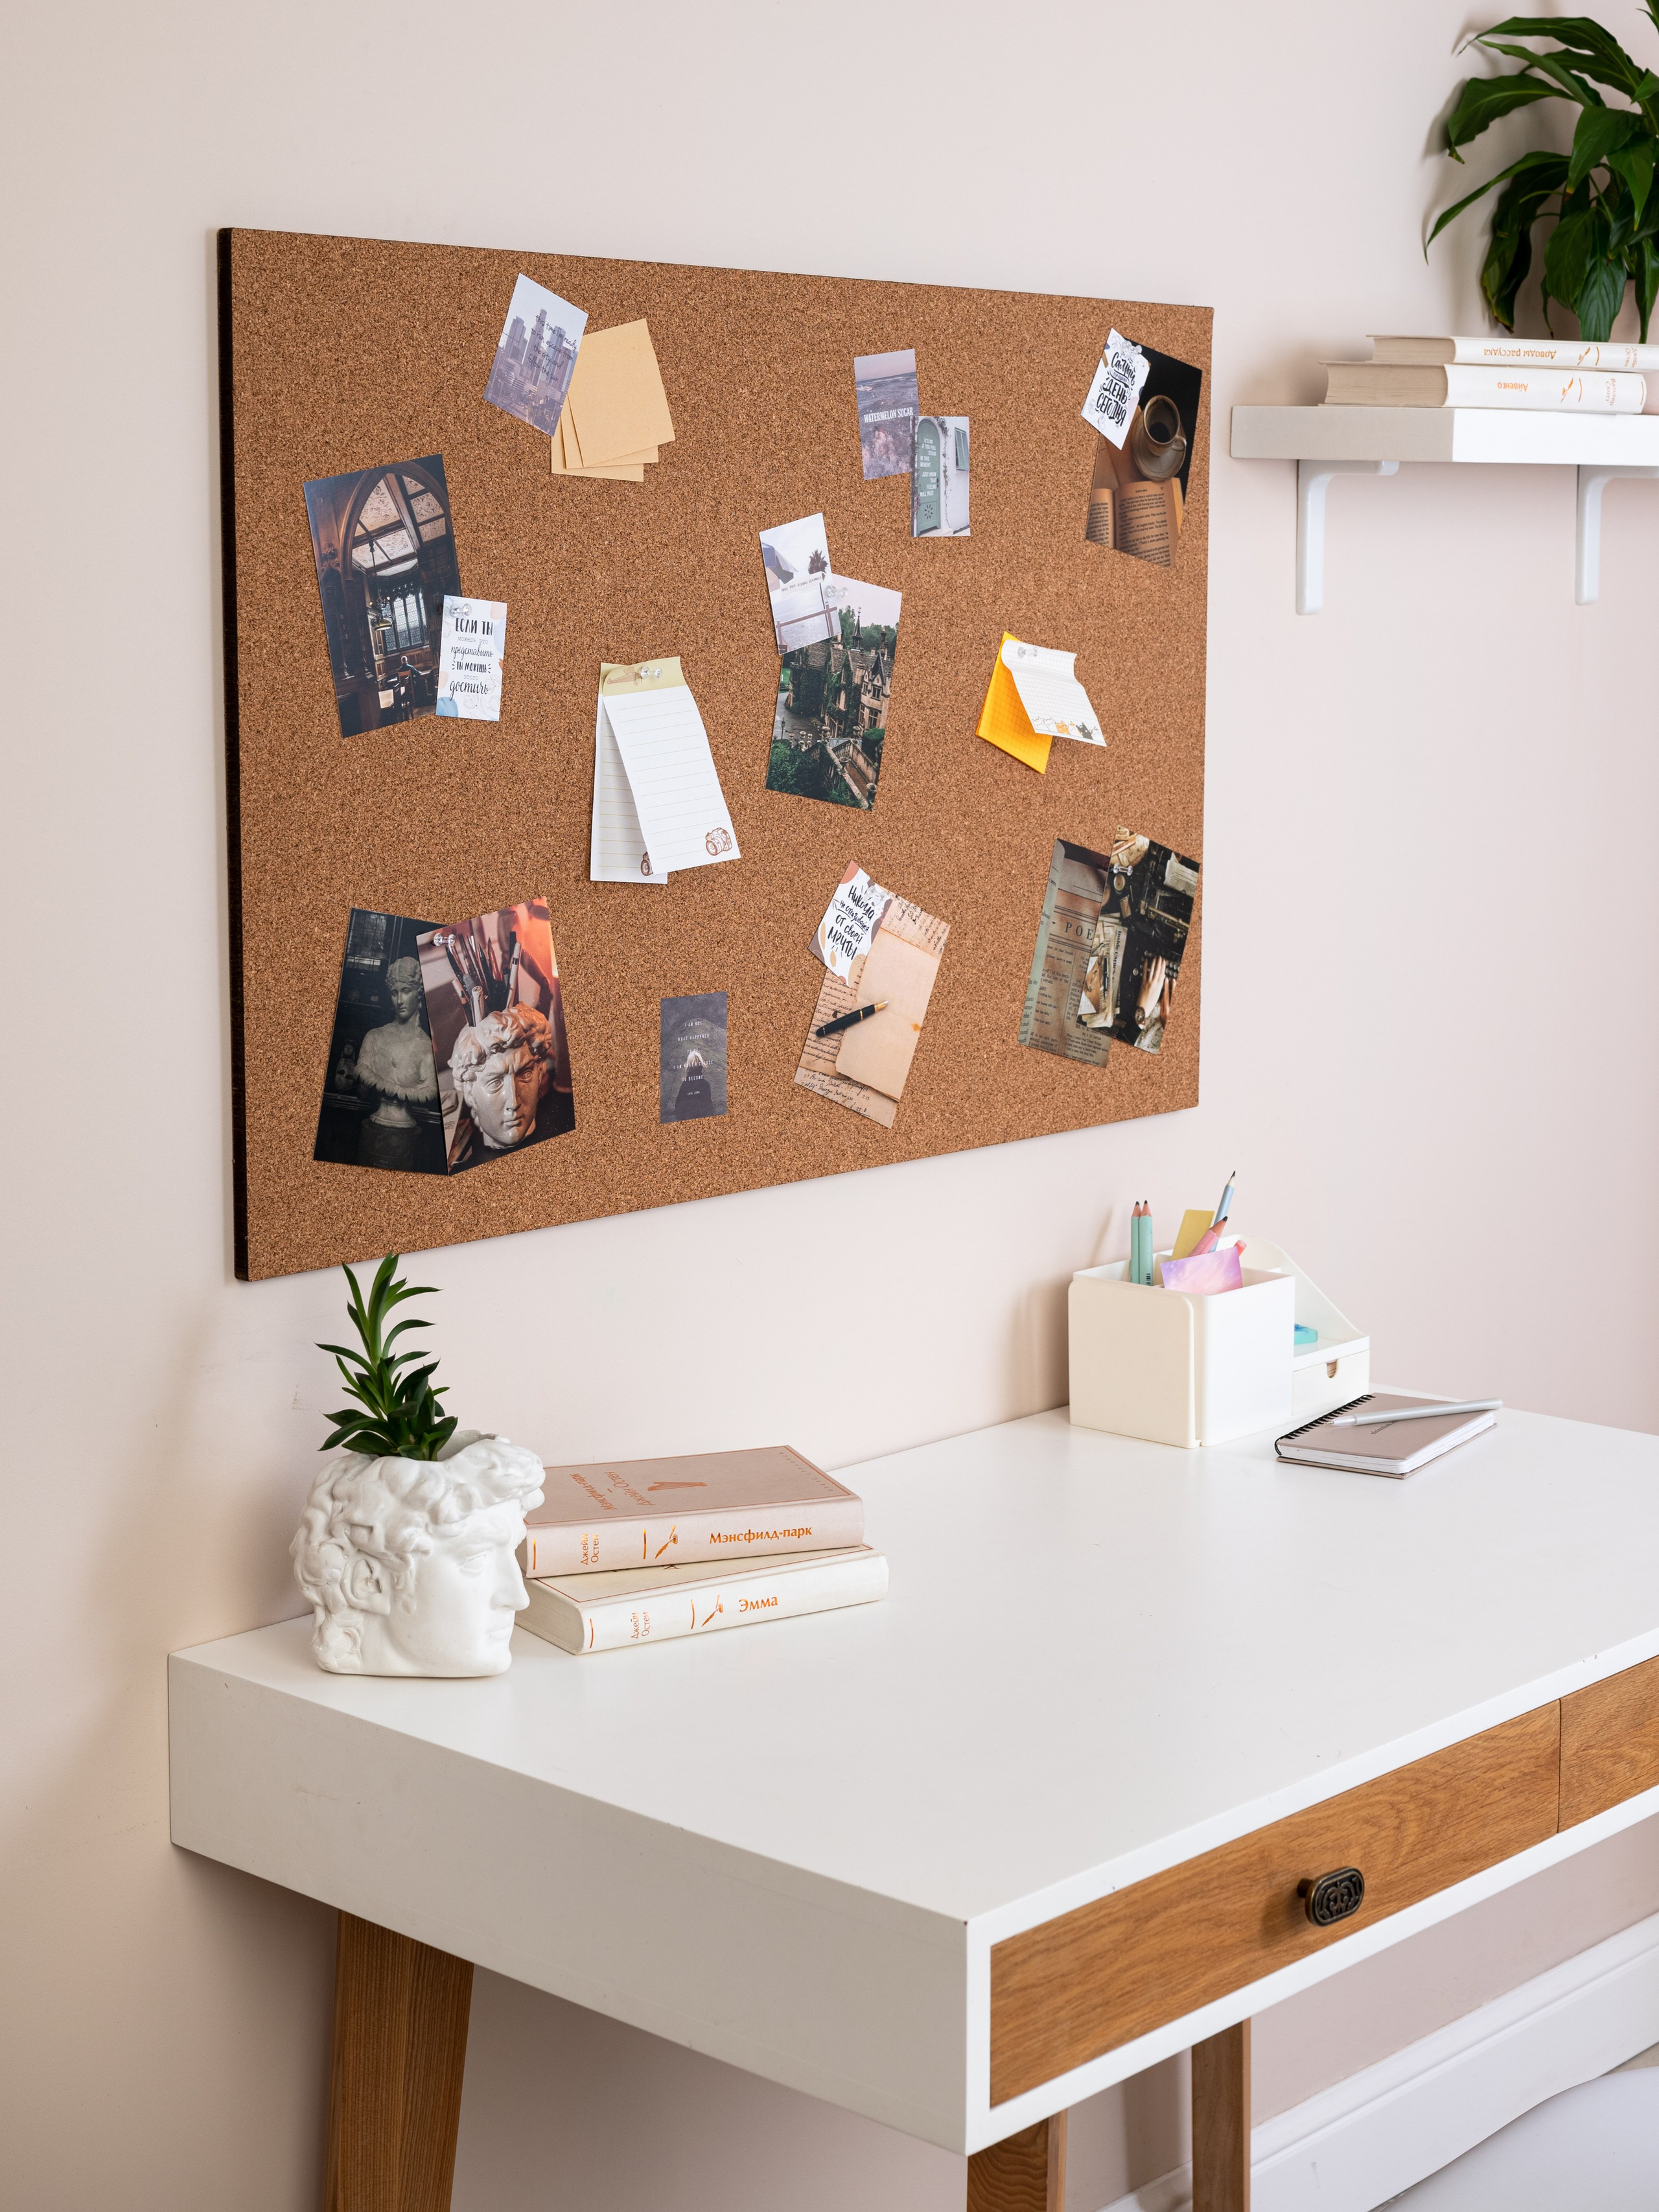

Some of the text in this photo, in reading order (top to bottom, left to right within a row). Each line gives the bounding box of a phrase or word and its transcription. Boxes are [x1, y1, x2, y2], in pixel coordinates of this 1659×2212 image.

[535, 313, 545, 327] this
[546, 323, 556, 334] time
[564, 337, 577, 354] ready
[533, 343, 542, 354] the
[546, 340, 563, 355] escape
[1483, 347, 1557, 360] Доводы рассудка
[527, 353, 541, 369] follow
[1102, 378, 1128, 404] ДЕНЬ
[1497, 382, 1529, 393] Айвенго
[864, 407, 914, 423] WATERMELON SUGAR
[456, 618, 493, 636] ЕСЛИ ТЫ
[450, 644, 494, 660] представить
[456, 661, 487, 673] ТЫ МОЖЕШЬ
[450, 681, 491, 701] достичь
[568, 1473, 618, 1511] Мэнсфилд-парк
[604, 1471, 655, 1506] Джейн Остен
[709, 1526, 813, 1544] Мэнсфилд-парк
[580, 1533, 589, 1565] Джейн
[590, 1534, 599, 1563] Остен
[739, 1596, 778, 1612] Эмма
[631, 1612, 640, 1640] Джейн
[641, 1611, 649, 1637] Остен
